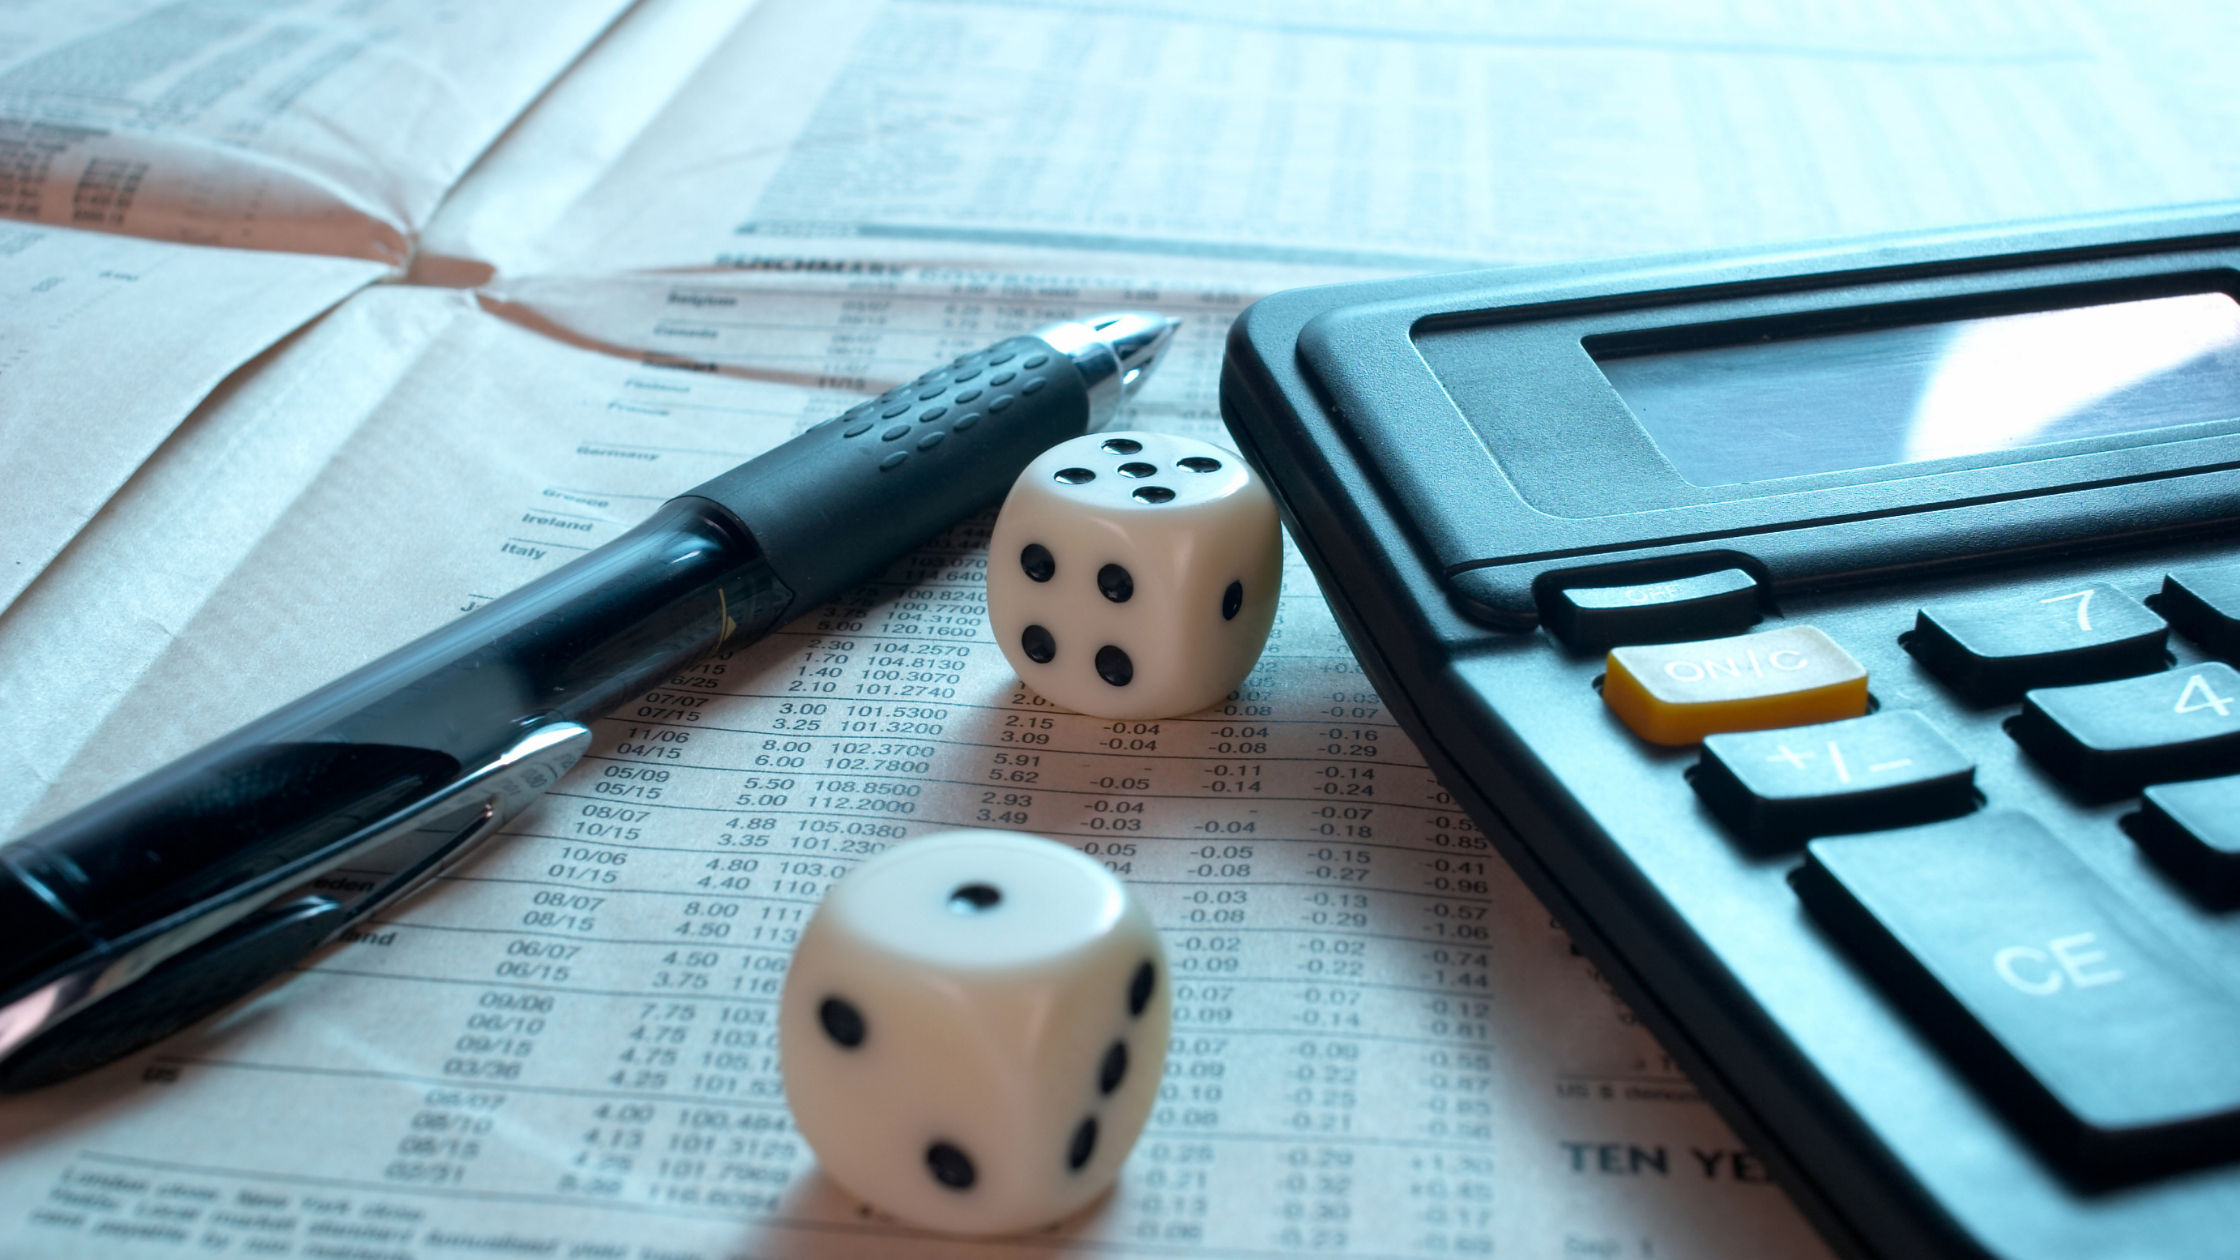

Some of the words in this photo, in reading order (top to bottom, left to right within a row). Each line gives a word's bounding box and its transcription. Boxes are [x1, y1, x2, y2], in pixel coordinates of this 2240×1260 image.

[576, 446, 660, 461] Germany
[543, 489, 609, 508] Greece
[522, 512, 594, 532] Ireland
[501, 542, 547, 561] Italy
[909, 556, 988, 569] 103.070
[904, 571, 988, 582] 114.640
[817, 620, 862, 632] 5.00
[881, 624, 977, 638] 120.1600
[887, 612, 981, 626] 104.3100
[892, 602, 986, 615] 100.7700
[2039, 588, 2096, 632] 7
[804, 652, 849, 665] 1.70
[867, 655, 966, 671] 104.8130
[809, 640, 855, 651] 2.30
[873, 642, 970, 657] 104.2570
[1663, 646, 1809, 683] ON/C
[798, 666, 843, 678] 1.40
[862, 669, 960, 685] 100.3070
[2173, 673, 2236, 717] 4
[670, 676, 719, 688] 6/25
[789, 681, 836, 693] 2.10
[855, 684, 956, 699] 101.2740
[1213, 705, 1272, 717] -0.08
[1320, 707, 1378, 719] -0.07
[637, 706, 702, 722] 07/15
[772, 718, 821, 731] 3.25
[840, 720, 943, 735] 101.3200
[1001, 731, 1050, 744] 3.09
[1099, 739, 1157, 751] -0.04
[1208, 742, 1267, 754] -0.08
[1317, 744, 1378, 757] -0.29
[779, 703, 828, 716] 3.00
[846, 705, 948, 720] 101.5300
[1005, 715, 1054, 729] 2.15
[1103, 722, 1160, 735] -0.04
[1210, 727, 1269, 738] -0.04
[1319, 729, 1378, 741] -0.16
[617, 742, 682, 759] 04/15
[755, 755, 805, 768] 6.00
[825, 757, 930, 774] 102.7800
[989, 769, 1039, 783] 5.62
[1090, 777, 1149, 789] -0.05
[1201, 781, 1262, 792] -0.14
[1313, 783, 1374, 797] -0.24
[627, 727, 689, 743] 11/06
[762, 740, 811, 753] 8.00
[831, 741, 935, 758] 102.3700
[994, 753, 1041, 767] 5.91
[1204, 765, 1262, 776] -0.11
[1315, 768, 1375, 780] -0.14
[595, 782, 663, 799] 05/15
[736, 794, 788, 808] 5.00
[807, 795, 915, 814] 112.2000
[976, 809, 1028, 824] 3.49
[1080, 818, 1141, 831] -0.03
[1194, 822, 1256, 833] -0.04
[1309, 824, 1372, 838] -0.18
[1425, 833, 1488, 850] -0.85
[604, 765, 670, 782] 05/09
[744, 777, 795, 791] 5.50
[814, 779, 921, 797] 108.8500
[981, 792, 1032, 807] 2.93
[1084, 800, 1144, 813] -0.04
[1311, 807, 1373, 821] -0.07
[1426, 816, 1483, 831] -0.5
[574, 821, 642, 840] 10/15
[717, 834, 769, 848] 3.35
[790, 836, 889, 855] 101.230
[1187, 865, 1251, 877] -0.08
[1305, 866, 1370, 881] -0.27
[1423, 878, 1488, 893] -0.96
[582, 804, 651, 822] 08/07
[725, 818, 776, 831] 4.88
[798, 819, 907, 839] 105.0380
[1191, 847, 1253, 859] -0.05
[1307, 848, 1371, 864] -0.15
[1425, 859, 1486, 875] -0.41
[548, 864, 618, 883] 01/15
[697, 877, 750, 891] 4.40
[1180, 910, 1245, 923] -0.08
[1301, 912, 1368, 927] -0.29
[1423, 923, 1489, 940] -1.06
[561, 847, 628, 866] 10/06
[705, 859, 758, 872] 4.80
[1182, 891, 1248, 904] -0.03
[1303, 893, 1368, 908] -0.13
[1422, 904, 1488, 920] -0.57
[522, 911, 595, 932] 08/15
[675, 922, 731, 938] 4.50
[1297, 959, 1363, 976] -0.22
[1422, 969, 1489, 988] -1.44
[533, 891, 605, 912] 08/07
[684, 902, 739, 919] 8.00
[1175, 937, 1241, 952] -0.02
[1299, 939, 1366, 956] -0.02
[1423, 950, 1489, 968] -0.74
[506, 940, 582, 961] 06/07
[662, 951, 719, 968] 4.50
[1177, 986, 1234, 1002] 0.07
[1993, 930, 2126, 996] CE
[495, 961, 570, 982] 06/15
[652, 972, 708, 989] 3.75
[1173, 1006, 1232, 1023] 0.09
[639, 1004, 696, 1021] 7.75
[629, 1026, 688, 1044] 4.75
[619, 1048, 678, 1067] 4.75
[1559, 1141, 1670, 1177] TEN
[1691, 1148, 1766, 1184] YE
